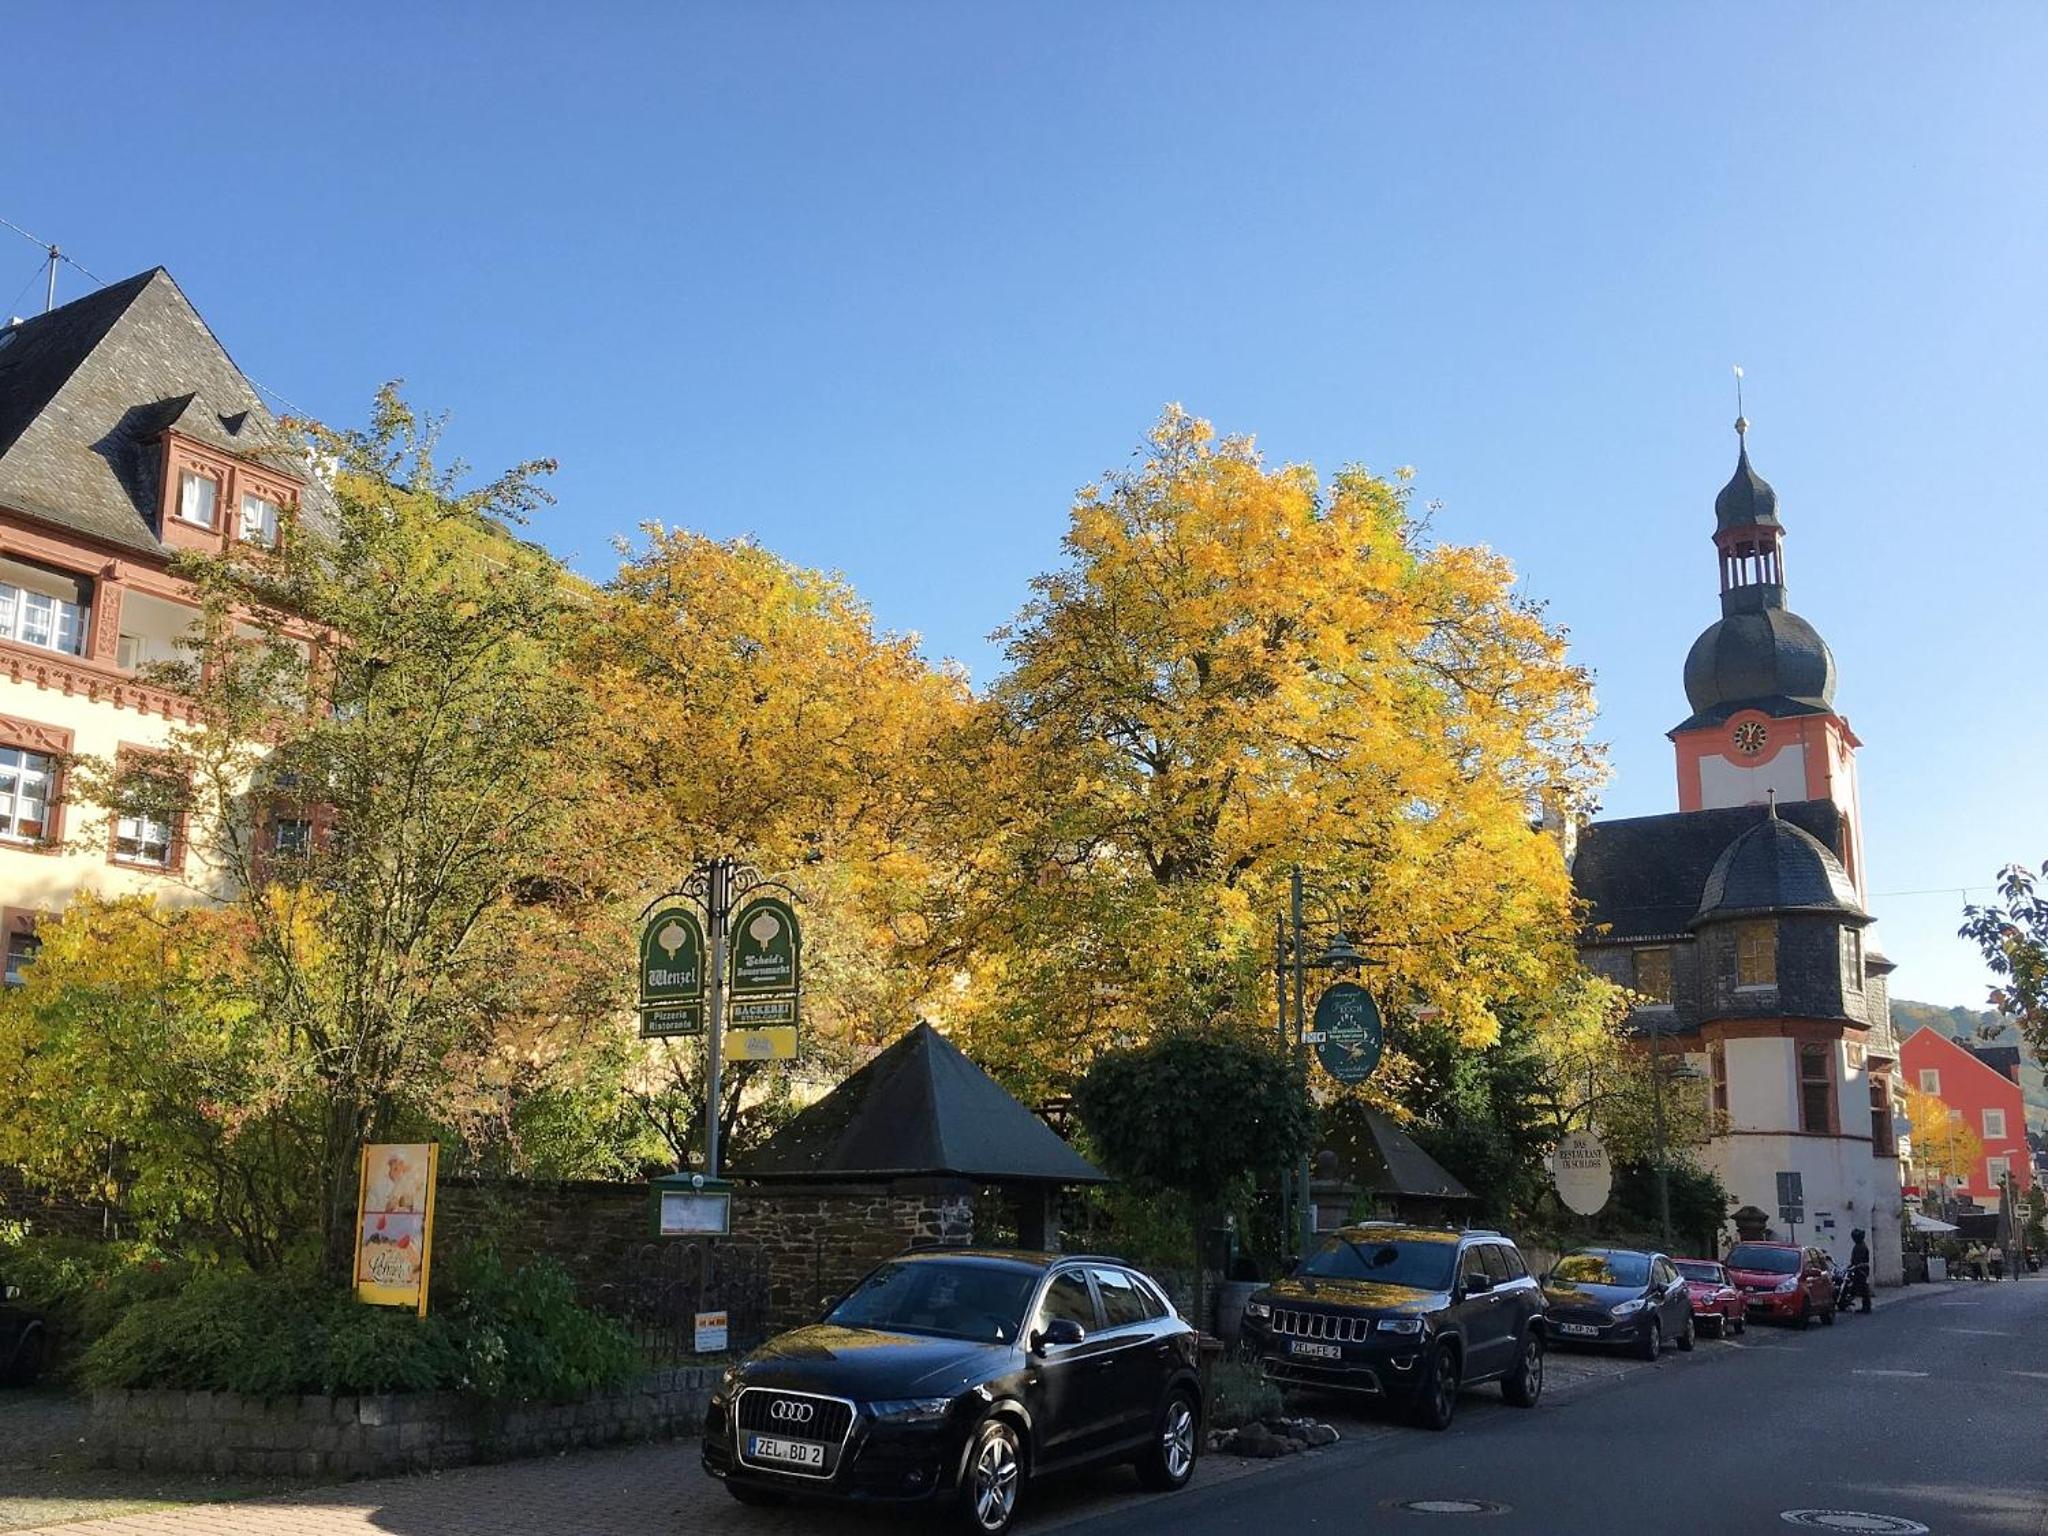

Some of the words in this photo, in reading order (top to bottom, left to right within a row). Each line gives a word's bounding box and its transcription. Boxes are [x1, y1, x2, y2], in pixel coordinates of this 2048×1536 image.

[648, 967, 696, 987] Wenzel
[653, 1010, 688, 1020] Pizzeria
[757, 1440, 782, 1457] ZEL
[789, 1444, 807, 1460] BD
[812, 1447, 821, 1464] 2
